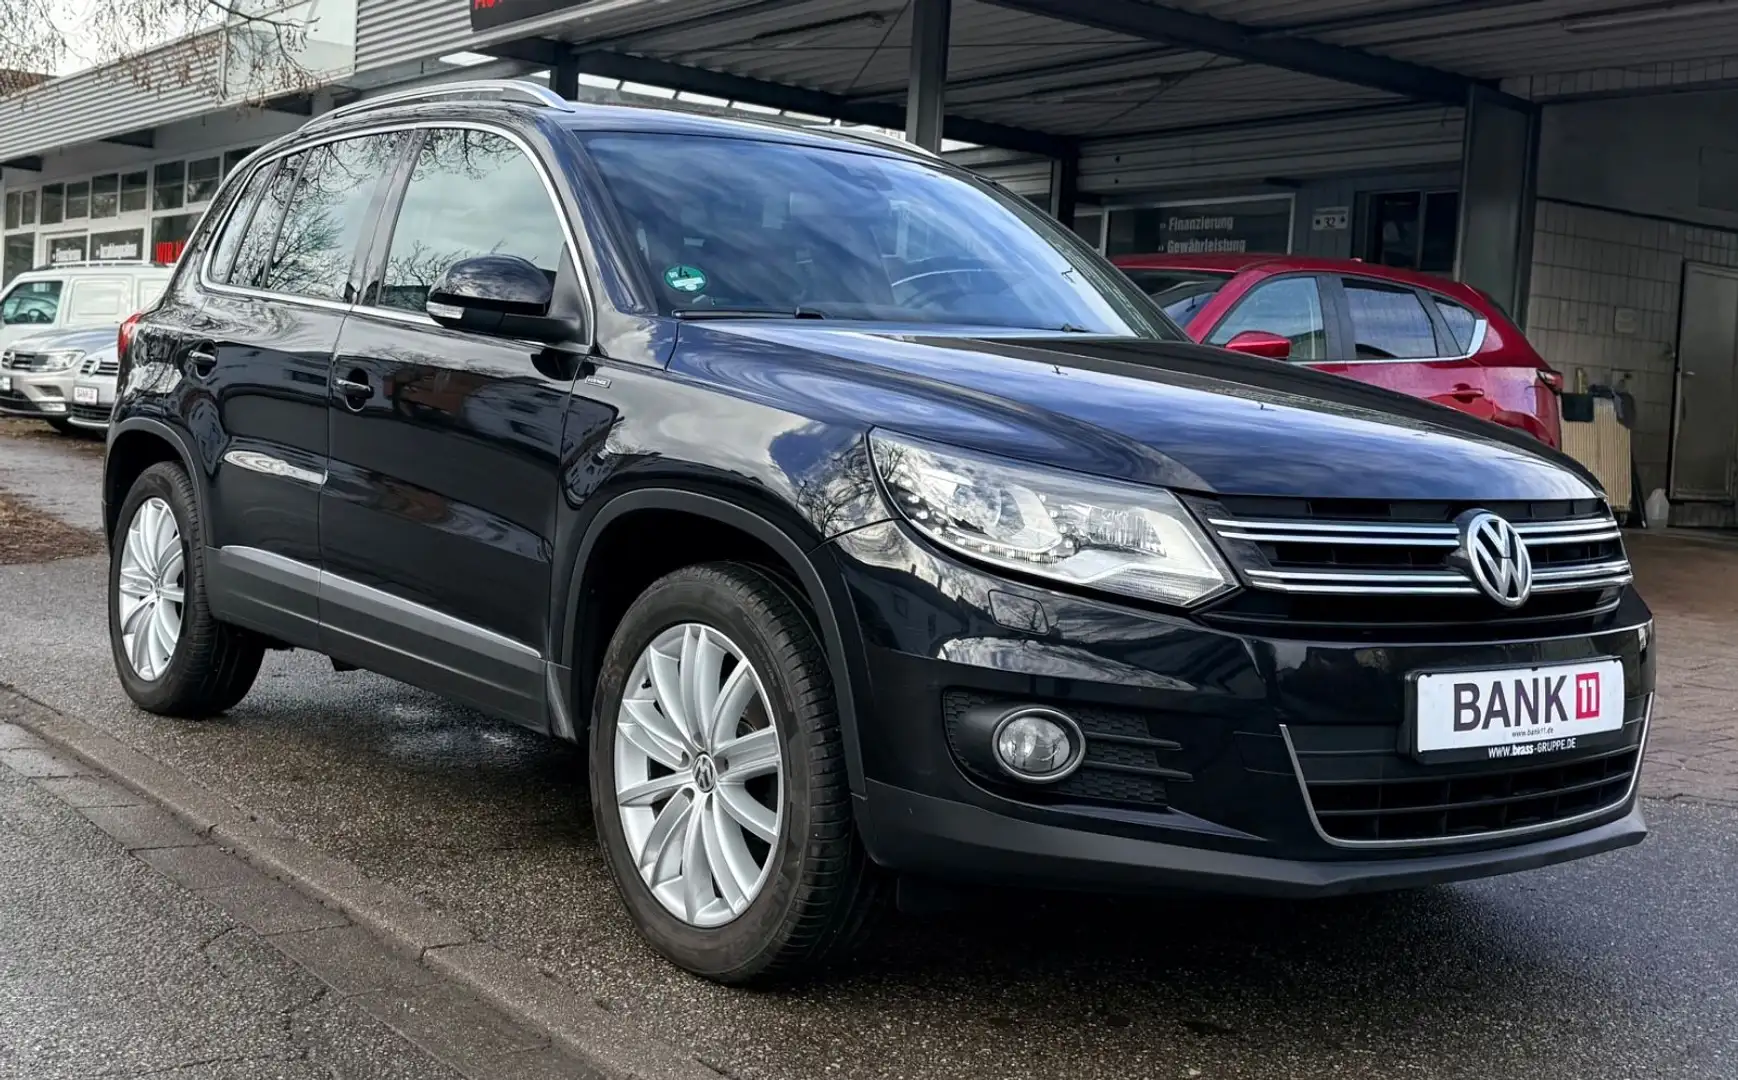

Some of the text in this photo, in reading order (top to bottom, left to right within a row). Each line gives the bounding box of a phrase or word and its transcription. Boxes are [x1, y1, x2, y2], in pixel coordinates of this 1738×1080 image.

[1168, 216, 1234, 231] Finanzierung
[1324, 216, 1336, 228] 32
[1167, 237, 1246, 253] Gewährleistung
[1453, 675, 1598, 732] BANK 11
[1512, 727, 1554, 737] www.bank11.de
[1488, 738, 1576, 758] WWW.brass-GRUPPE.DE
